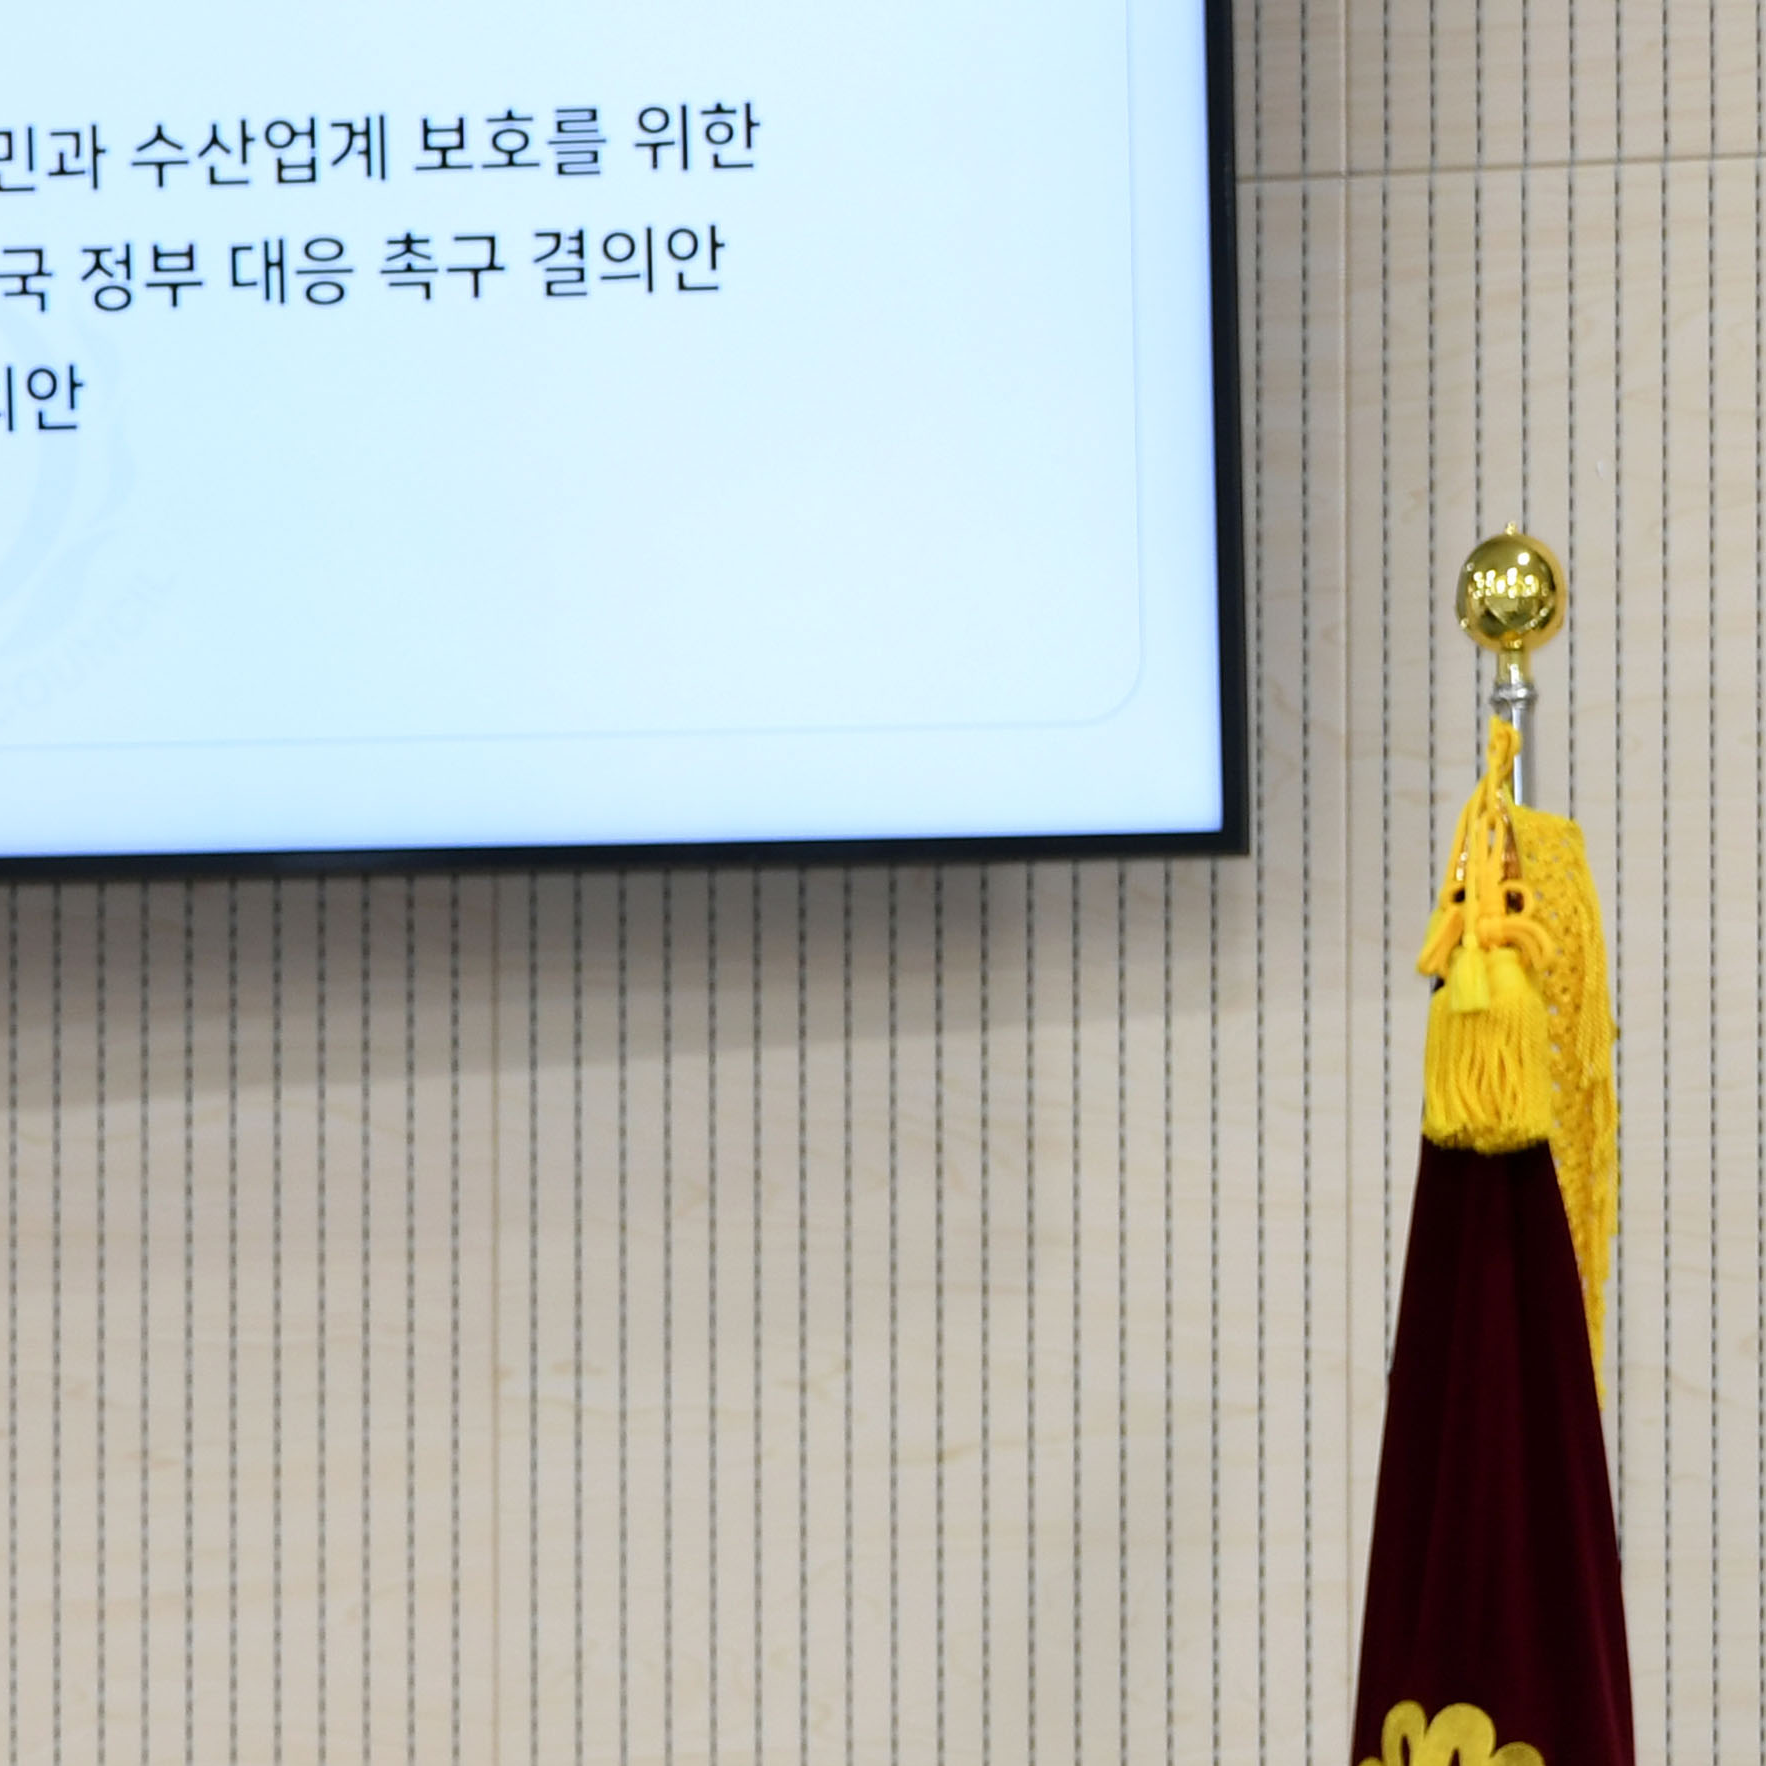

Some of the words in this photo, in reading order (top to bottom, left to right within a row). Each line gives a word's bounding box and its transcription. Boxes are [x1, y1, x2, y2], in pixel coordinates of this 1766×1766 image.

[130, 113, 387, 190] 수산업계
[414, 107, 608, 177] 보호를
[633, 100, 762, 173] 위한
[80, 241, 204, 313] 정부
[230, 236, 355, 307] 대응
[378, 231, 507, 302] 촉구
[532, 223, 726, 298] 결의안
